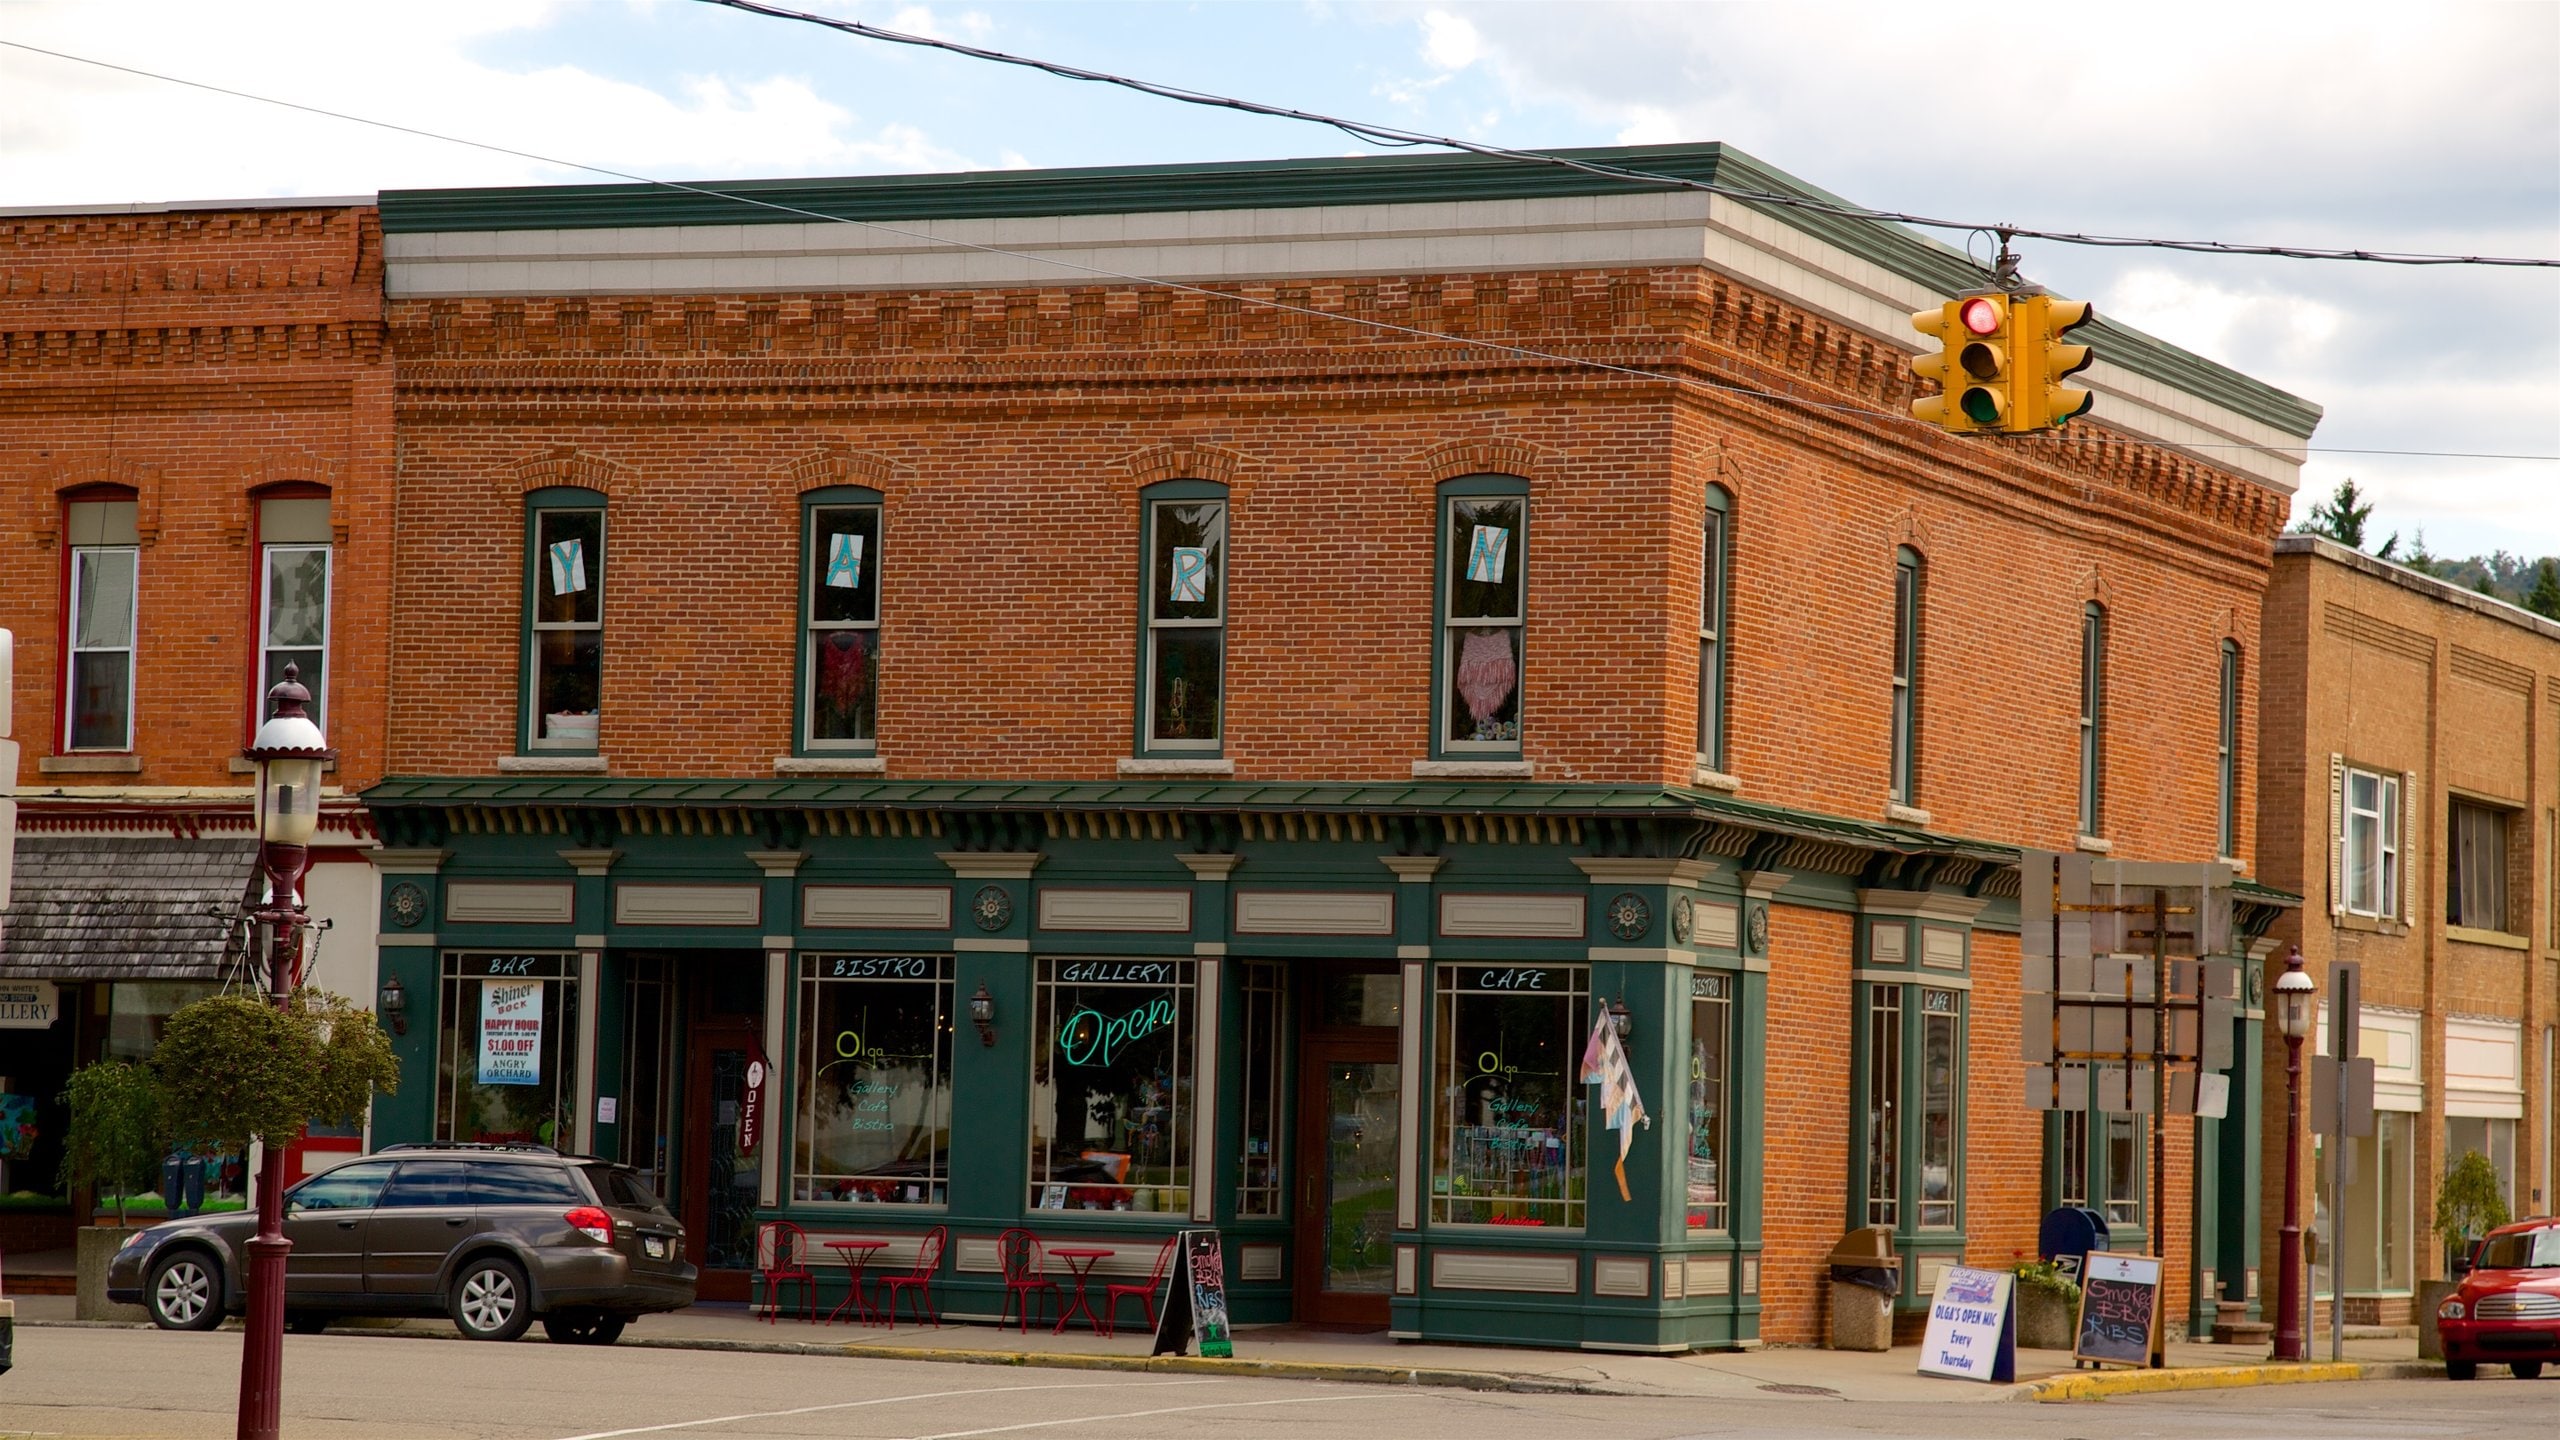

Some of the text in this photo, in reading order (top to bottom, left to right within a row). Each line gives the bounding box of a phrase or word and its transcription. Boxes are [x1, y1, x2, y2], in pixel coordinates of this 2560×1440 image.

[550, 525, 1509, 602] Y A R N
[488, 956, 536, 976] BAR
[833, 957, 926, 978] BISTRO
[1062, 962, 1171, 983] GALLERY
[1480, 968, 1547, 990] CAFE
[1691, 977, 1720, 997] BISTRO
[491, 983, 535, 1008] Shiner
[1927, 991, 1949, 1011] CAFE
[1, 1003, 51, 1020] LLERY
[498, 1000, 527, 1015] BOCK
[485, 1019, 539, 1031] HAPPY HOUR
[1060, 1000, 1176, 1067] Open
[488, 1038, 535, 1052] $1.00 OFF
[486, 1068, 532, 1079] ORCHARD
[492, 1059, 527, 1069] ANGRY
[851, 1080, 898, 1096] Gallery
[858, 1099, 890, 1112] Cafe
[1488, 1096, 1540, 1117] Gallery
[743, 1090, 757, 1147] OPEN
[852, 1117, 895, 1131] Bistro
[1951, 1268, 1972, 1279] HOP
[2087, 1279, 2155, 1309] Smoked
[1935, 1304, 1998, 1327] OLGA'S OPEN MIC
[2096, 1300, 2152, 1334] BBQ
[2086, 1312, 2145, 1344] RIBS
[1950, 1329, 1973, 1349] Every
[1939, 1350, 1974, 1372] Thursday
